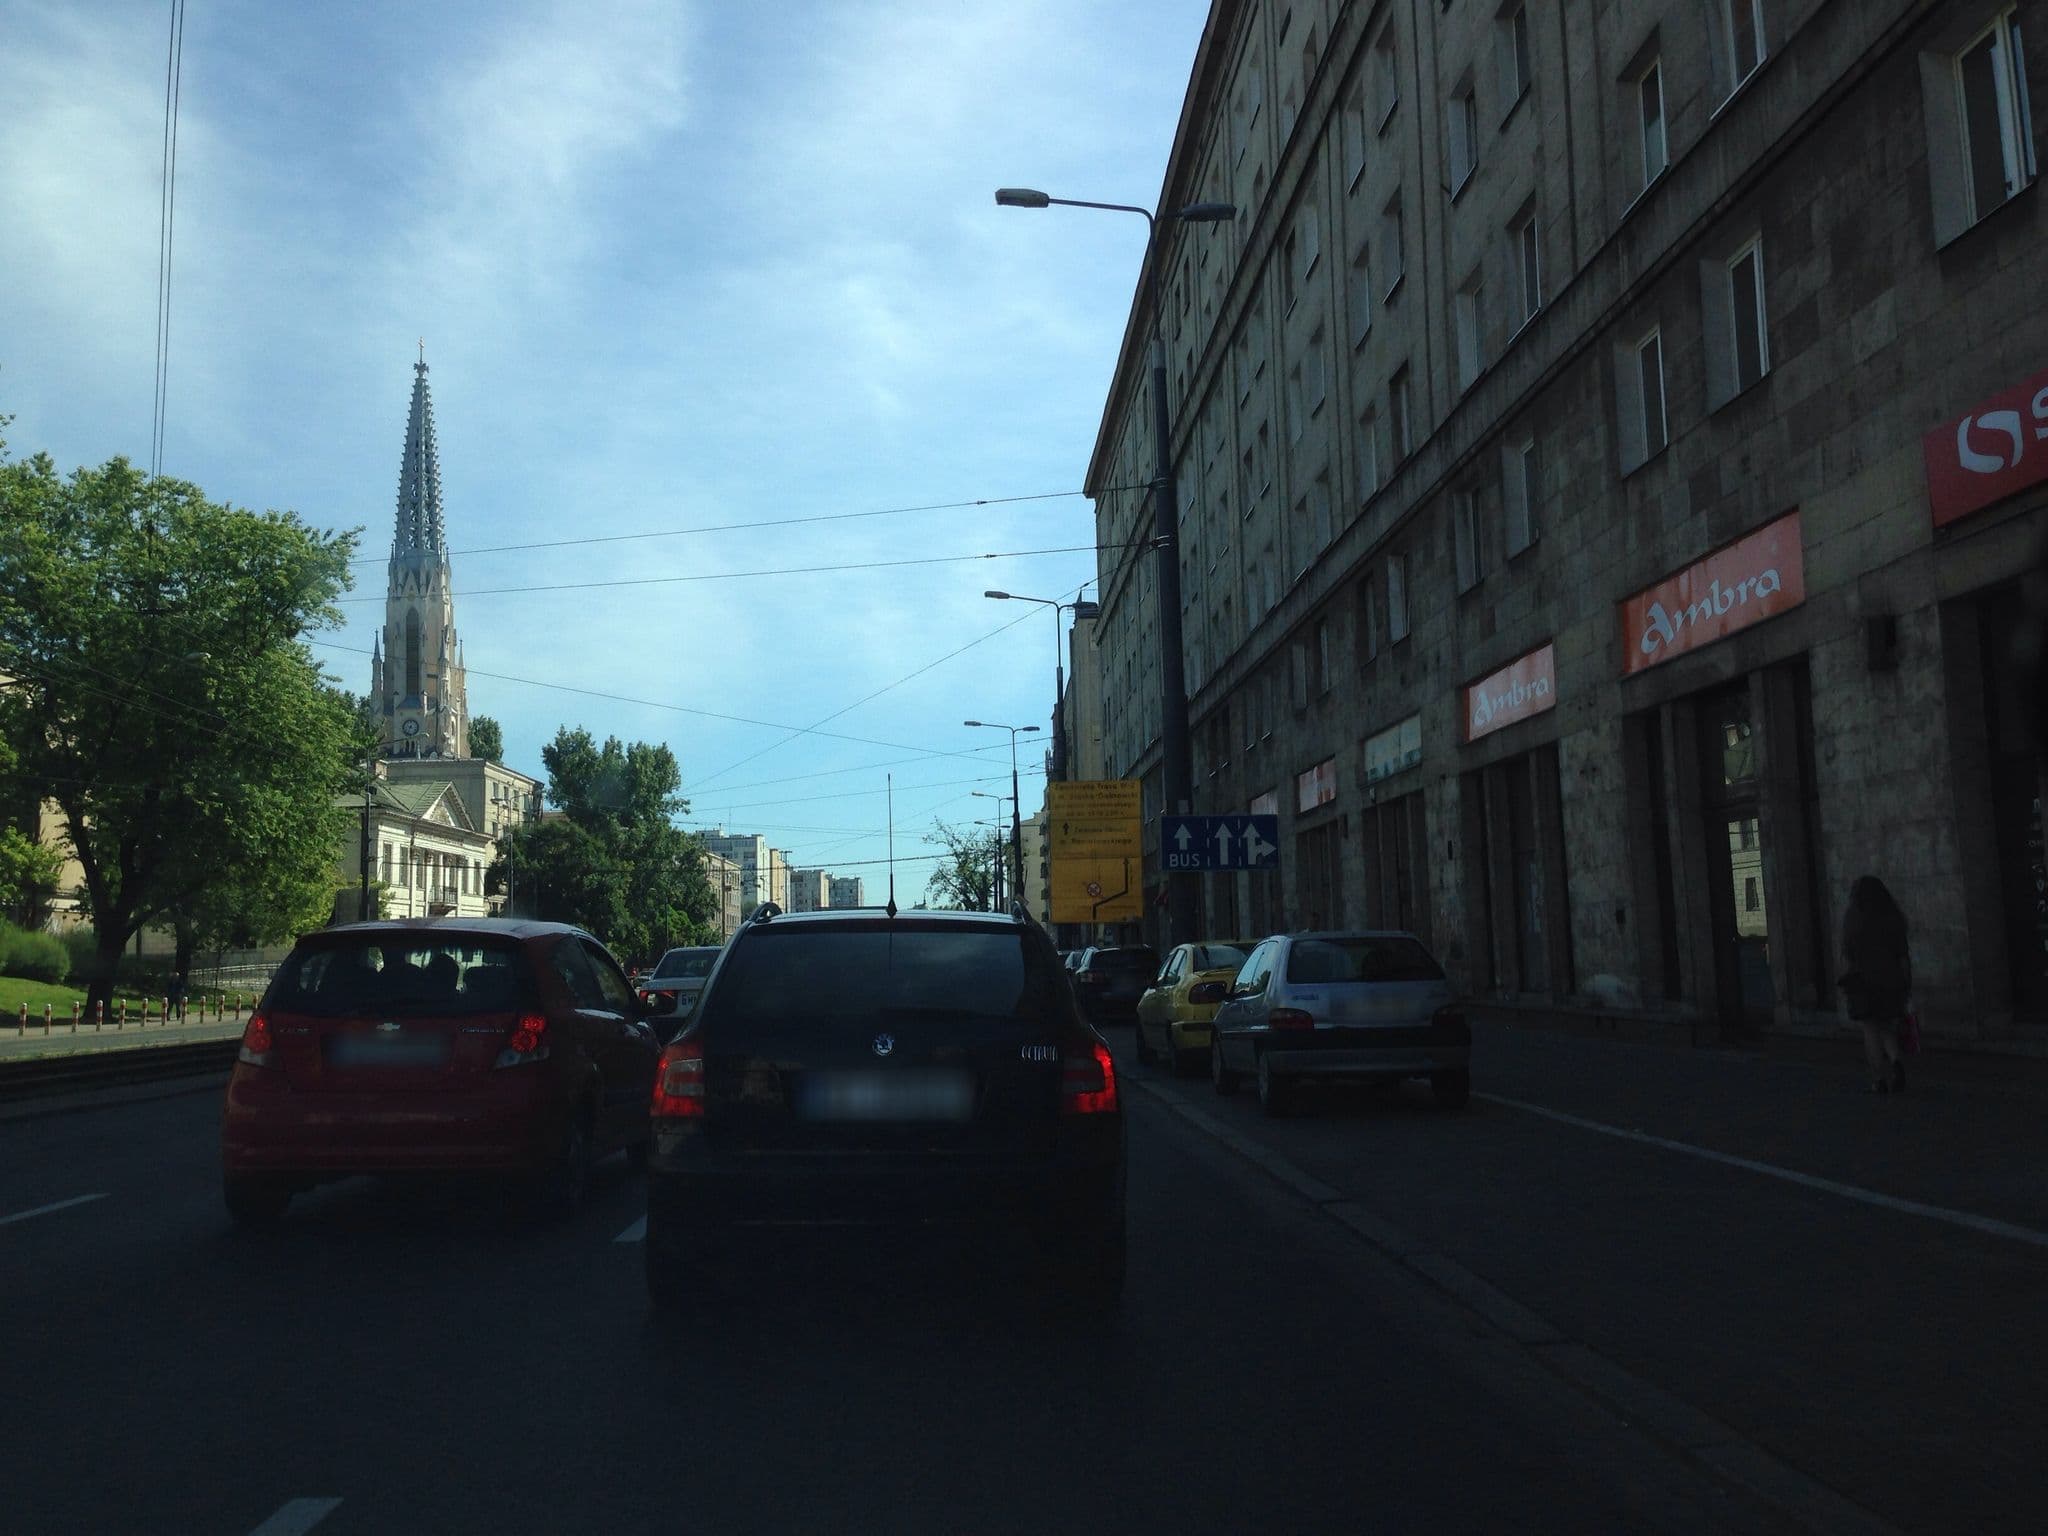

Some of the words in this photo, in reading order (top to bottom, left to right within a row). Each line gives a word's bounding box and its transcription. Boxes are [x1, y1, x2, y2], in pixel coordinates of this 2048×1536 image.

[1640, 568, 1782, 655] Ambra
[1473, 676, 1551, 727] Ambra
[1168, 853, 1201, 868] BUS
